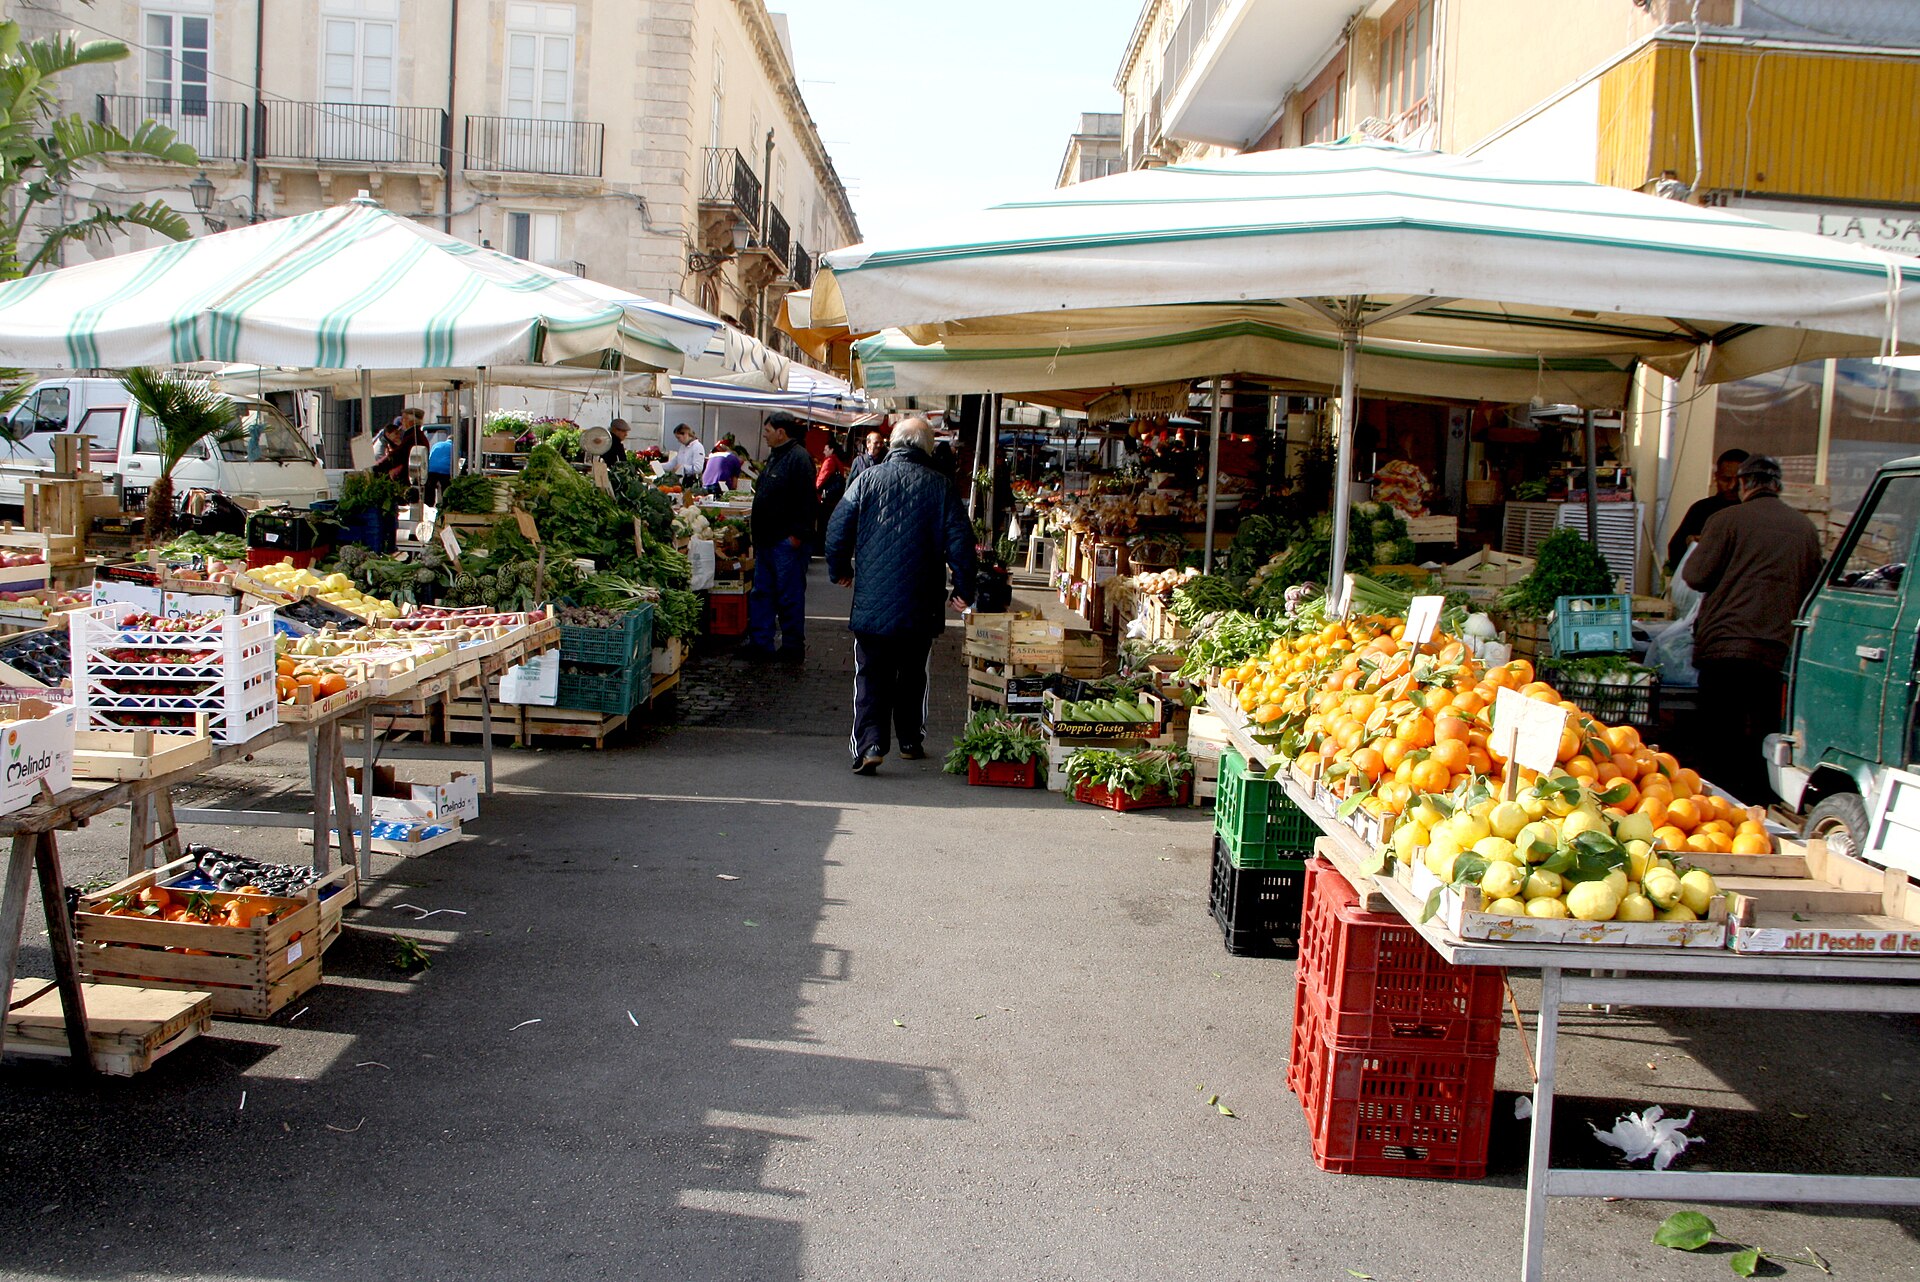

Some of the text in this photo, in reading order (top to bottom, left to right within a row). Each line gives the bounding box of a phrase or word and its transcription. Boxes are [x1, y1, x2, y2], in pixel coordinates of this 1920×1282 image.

[1817, 215, 1865, 239] LA
[1057, 722, 1124, 735] Doppio Gusto
[7, 750, 52, 783] Melinda
[440, 797, 466, 815] Melinda
[1784, 931, 1814, 950] olci
[1817, 931, 1875, 950] Pesche
[1879, 933, 1898, 951] di
